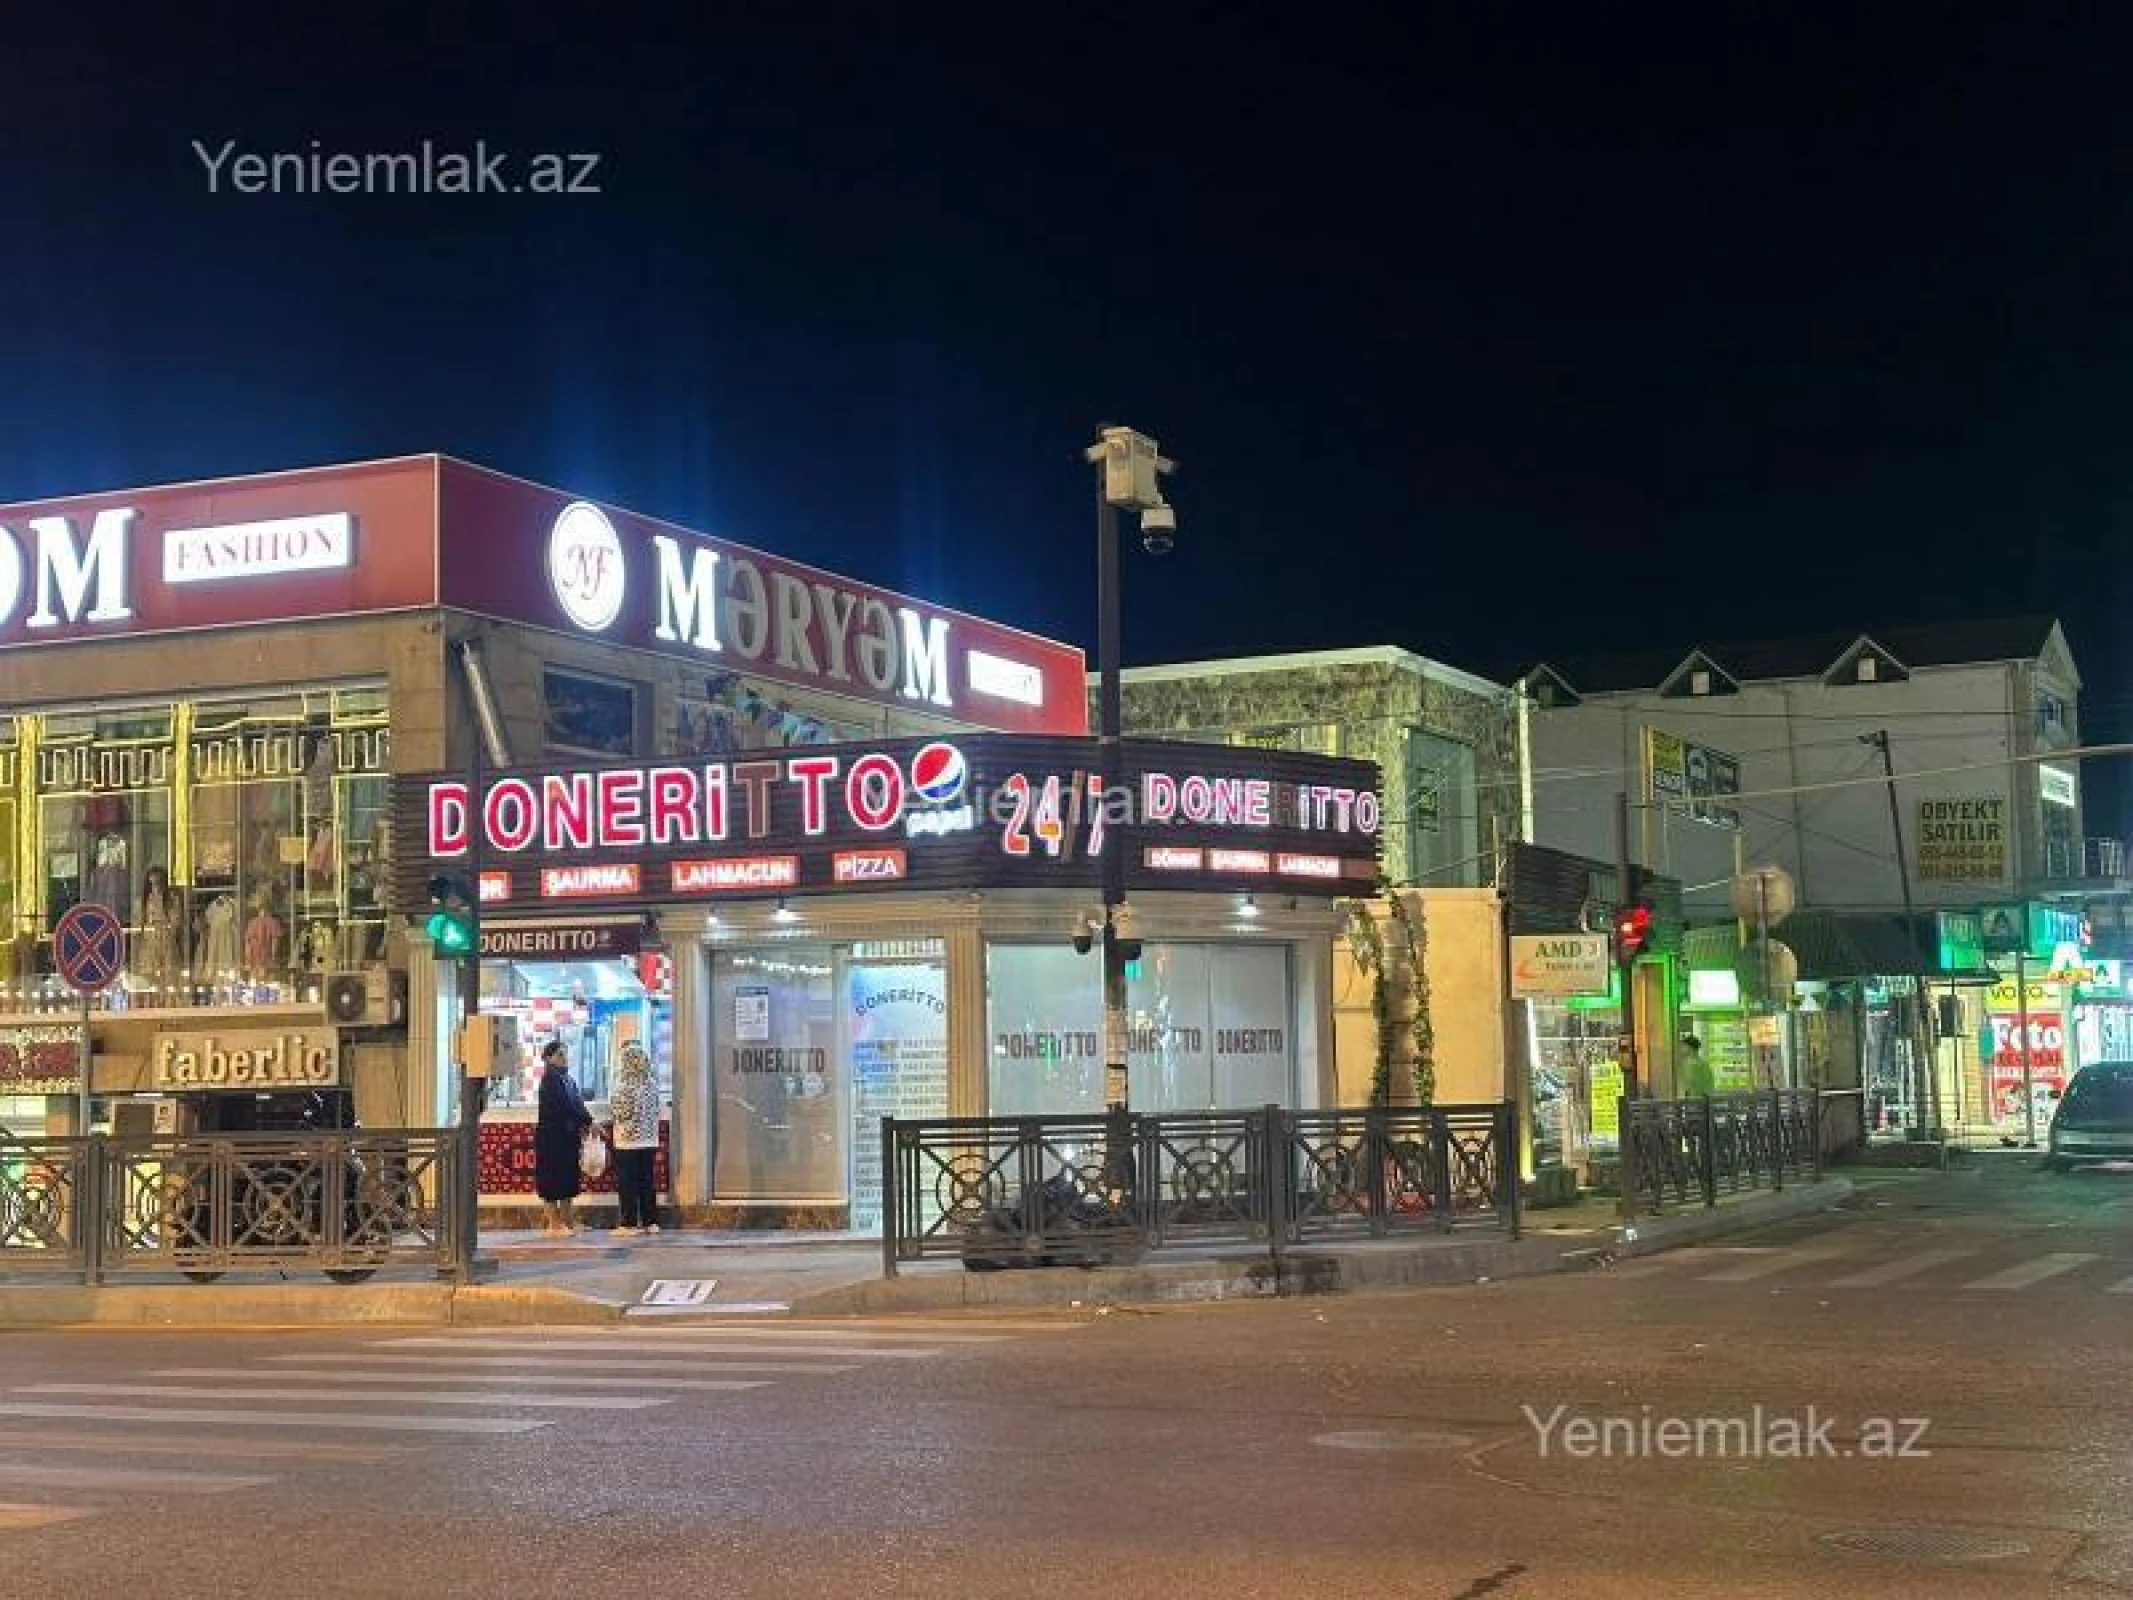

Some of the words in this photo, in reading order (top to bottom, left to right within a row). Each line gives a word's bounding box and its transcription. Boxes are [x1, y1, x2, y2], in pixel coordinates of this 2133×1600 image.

[0, 508, 134, 627] M
[177, 527, 341, 571] FASHION
[1921, 800, 2003, 819] OBYEKT
[159, 1036, 331, 1083] faberlic
